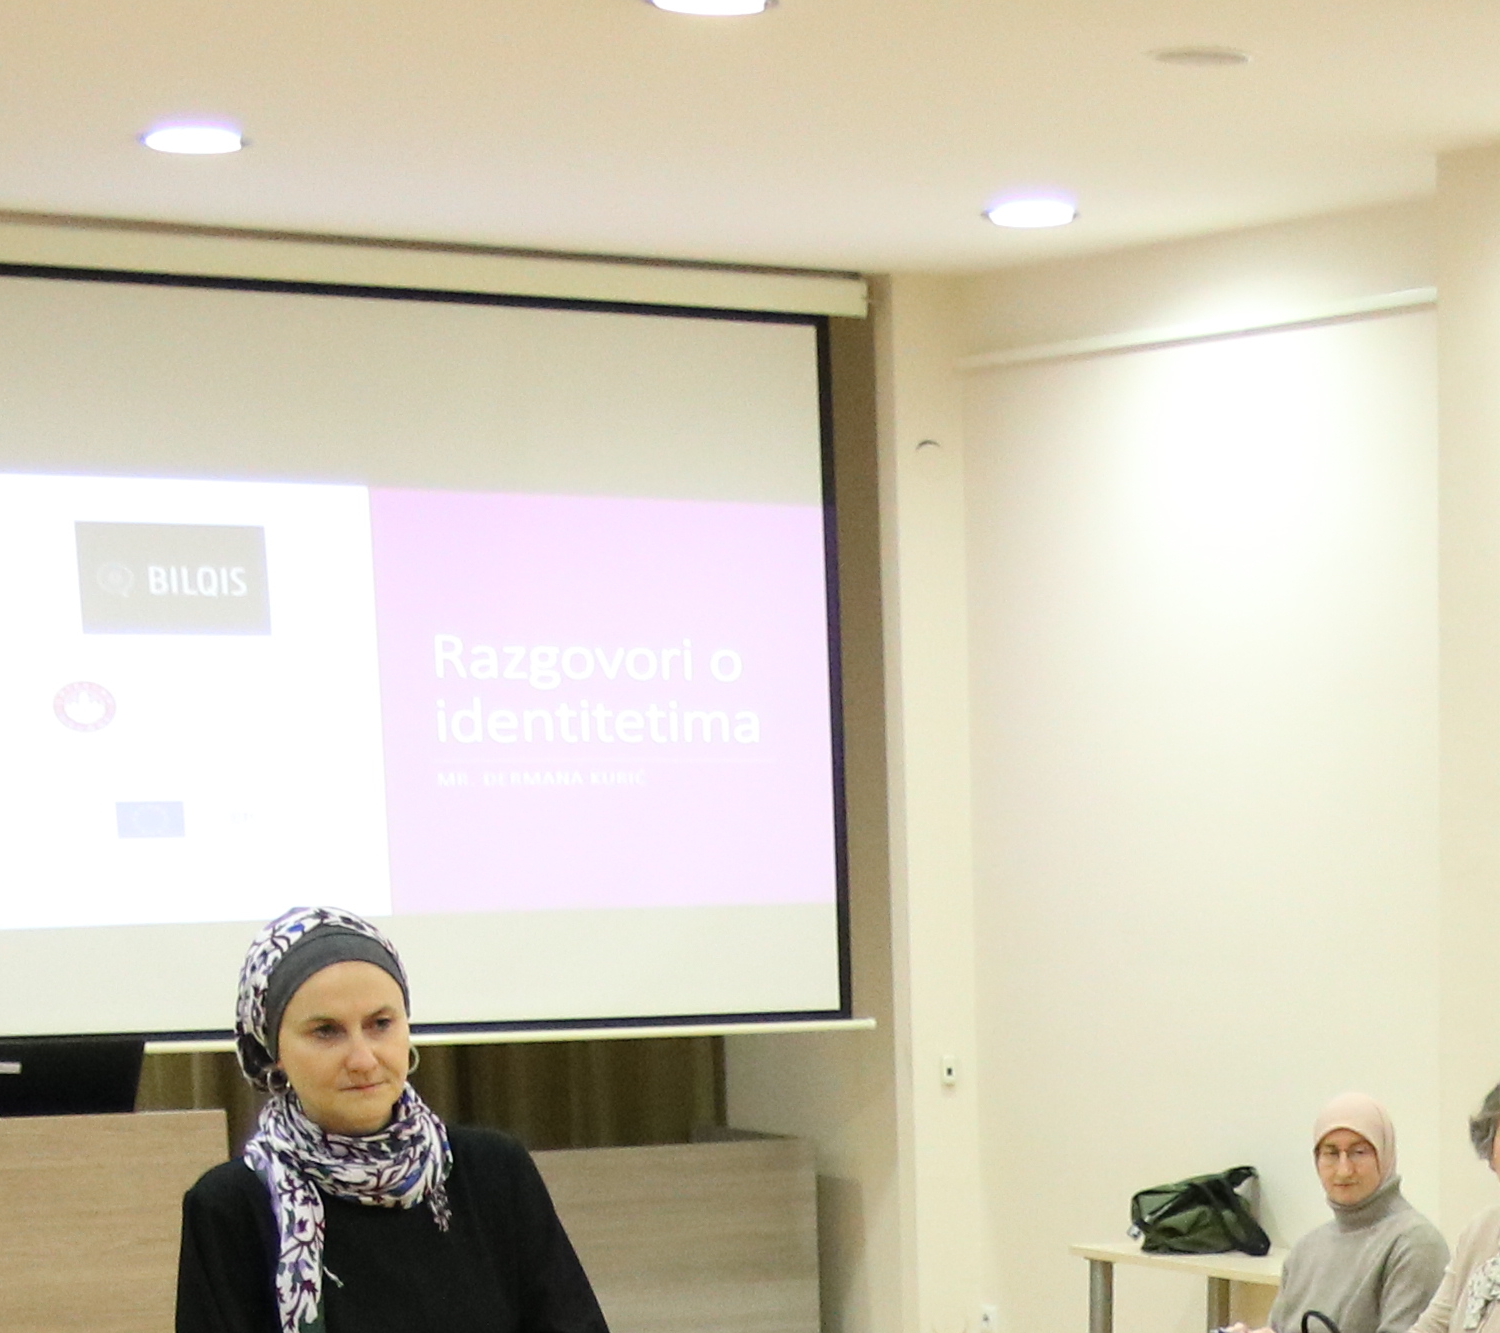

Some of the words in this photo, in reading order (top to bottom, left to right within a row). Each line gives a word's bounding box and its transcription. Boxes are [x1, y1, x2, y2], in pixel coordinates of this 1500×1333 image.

[148, 565, 248, 598] BILQIS
[433, 632, 694, 691] Razgovori
[709, 646, 744, 683] o
[435, 695, 761, 744] identitetima
